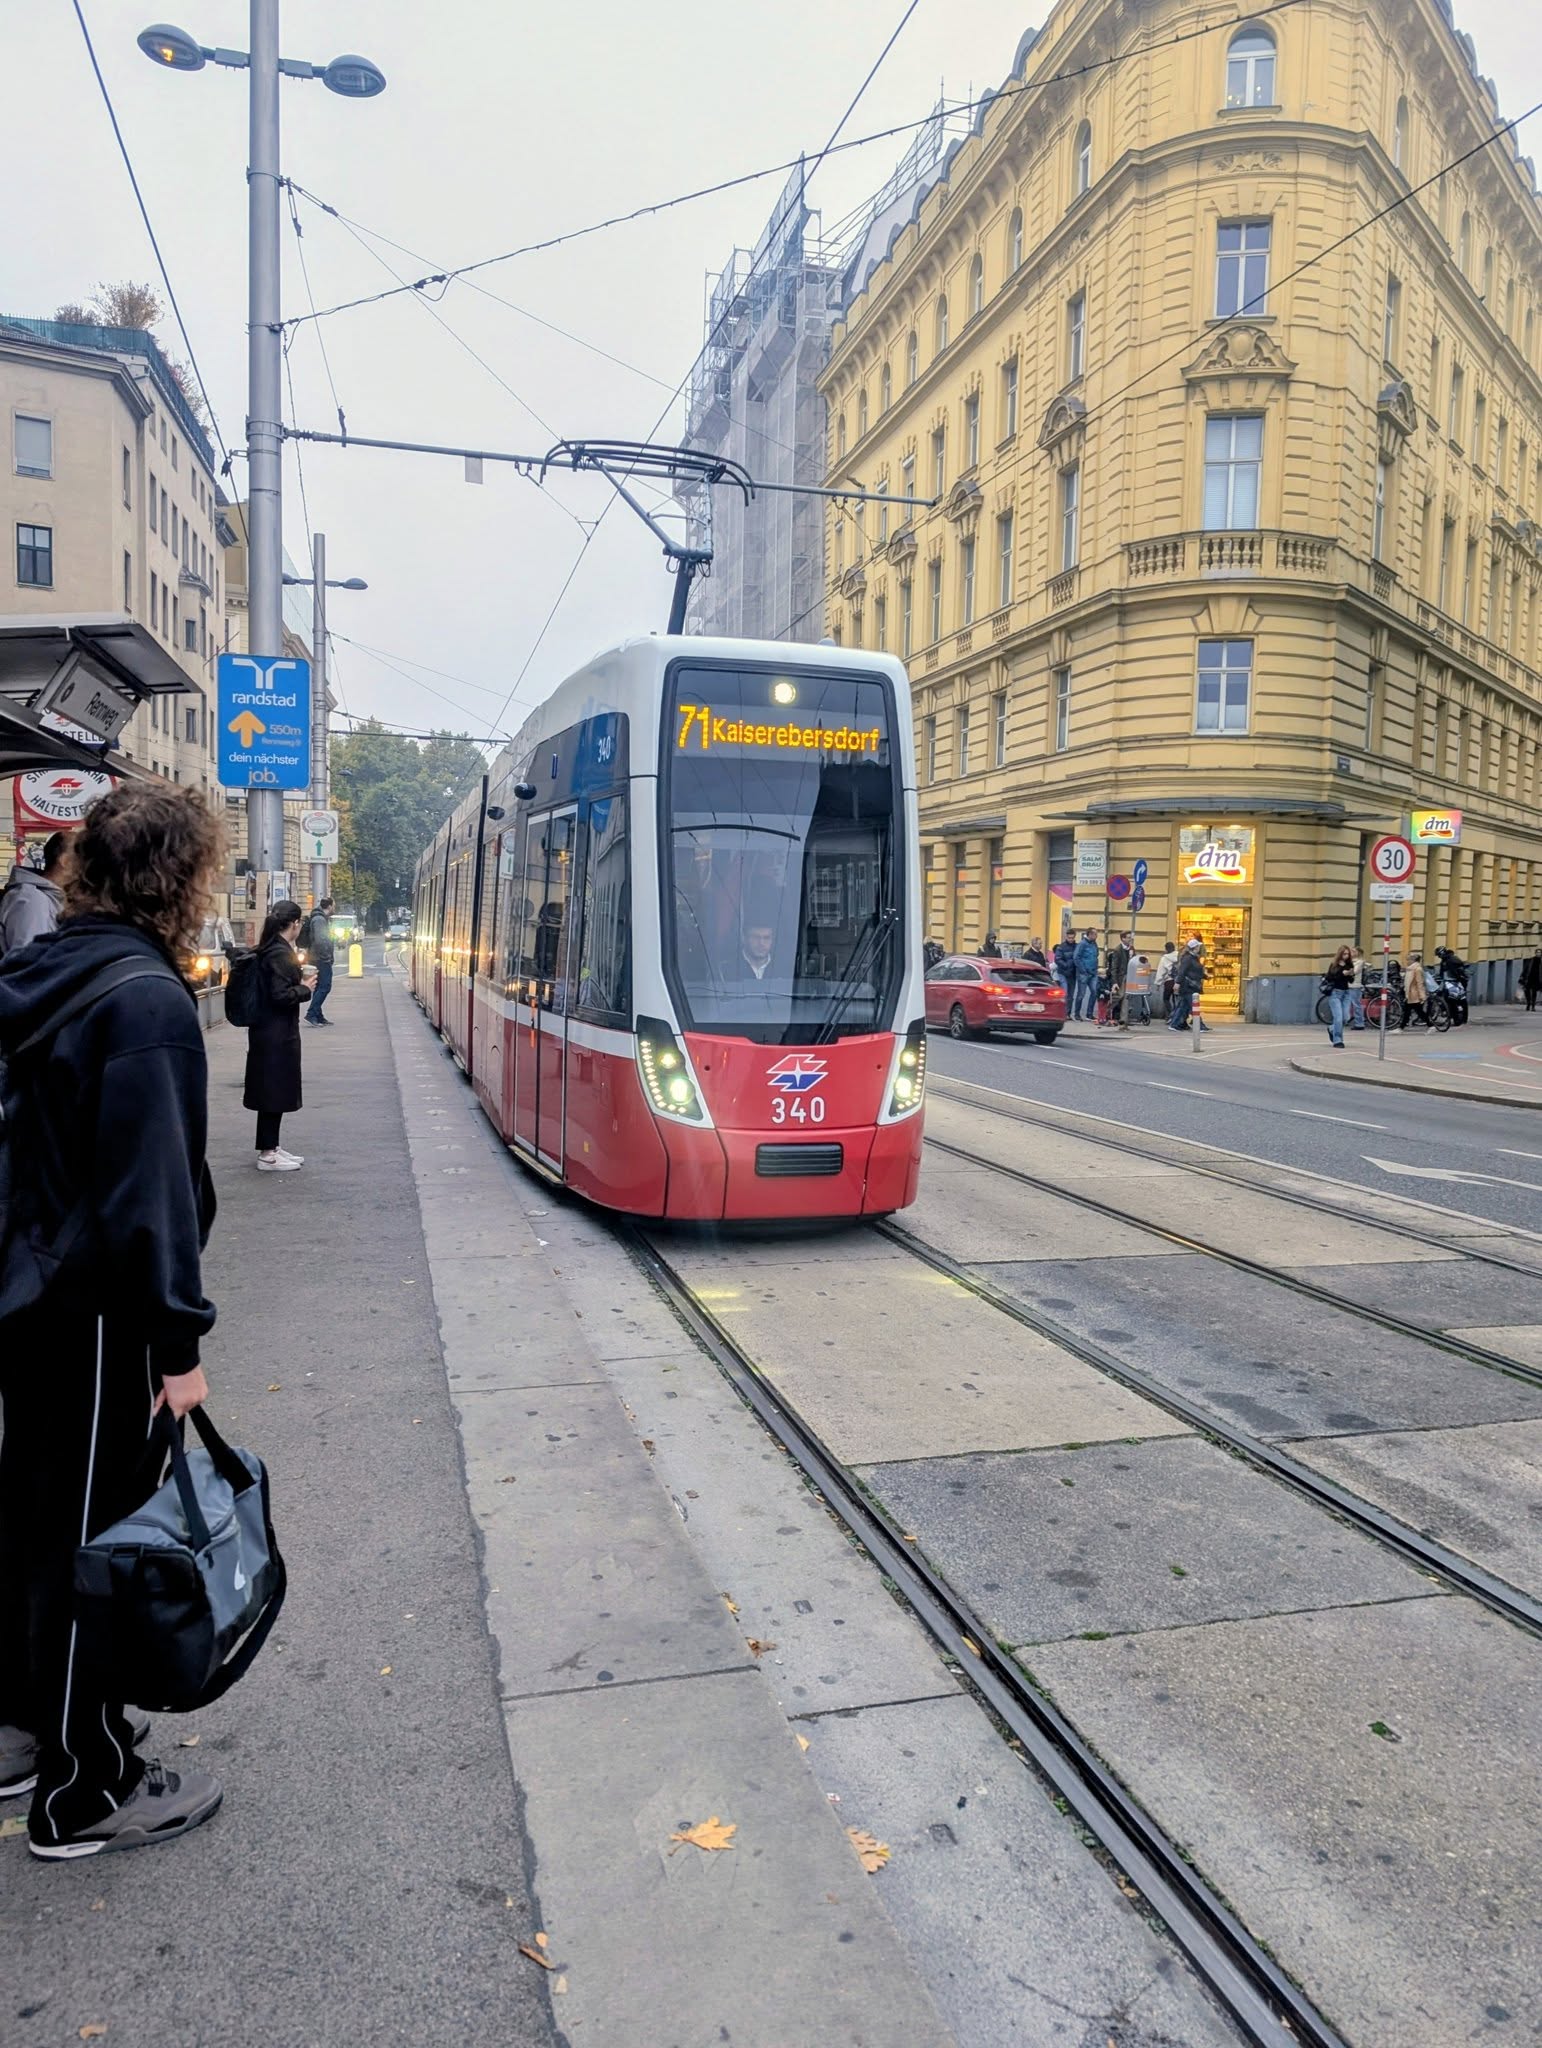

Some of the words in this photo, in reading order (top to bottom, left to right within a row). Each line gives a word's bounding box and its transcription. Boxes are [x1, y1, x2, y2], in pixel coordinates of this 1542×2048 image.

[232, 691, 297, 707] randstad
[84, 692, 119, 731] Rennweg
[269, 724, 302, 736] 550m
[678, 704, 711, 749] 71
[713, 717, 880, 751] Kaiserebersdorf
[228, 751, 252, 763] dein
[254, 753, 299, 765] nächster
[597, 735, 612, 763] 340
[248, 766, 279, 785] job.
[1424, 816, 1450, 830] dm
[1198, 846, 1238, 867] dm
[1381, 848, 1404, 870] 30
[771, 1096, 825, 1124] 340
